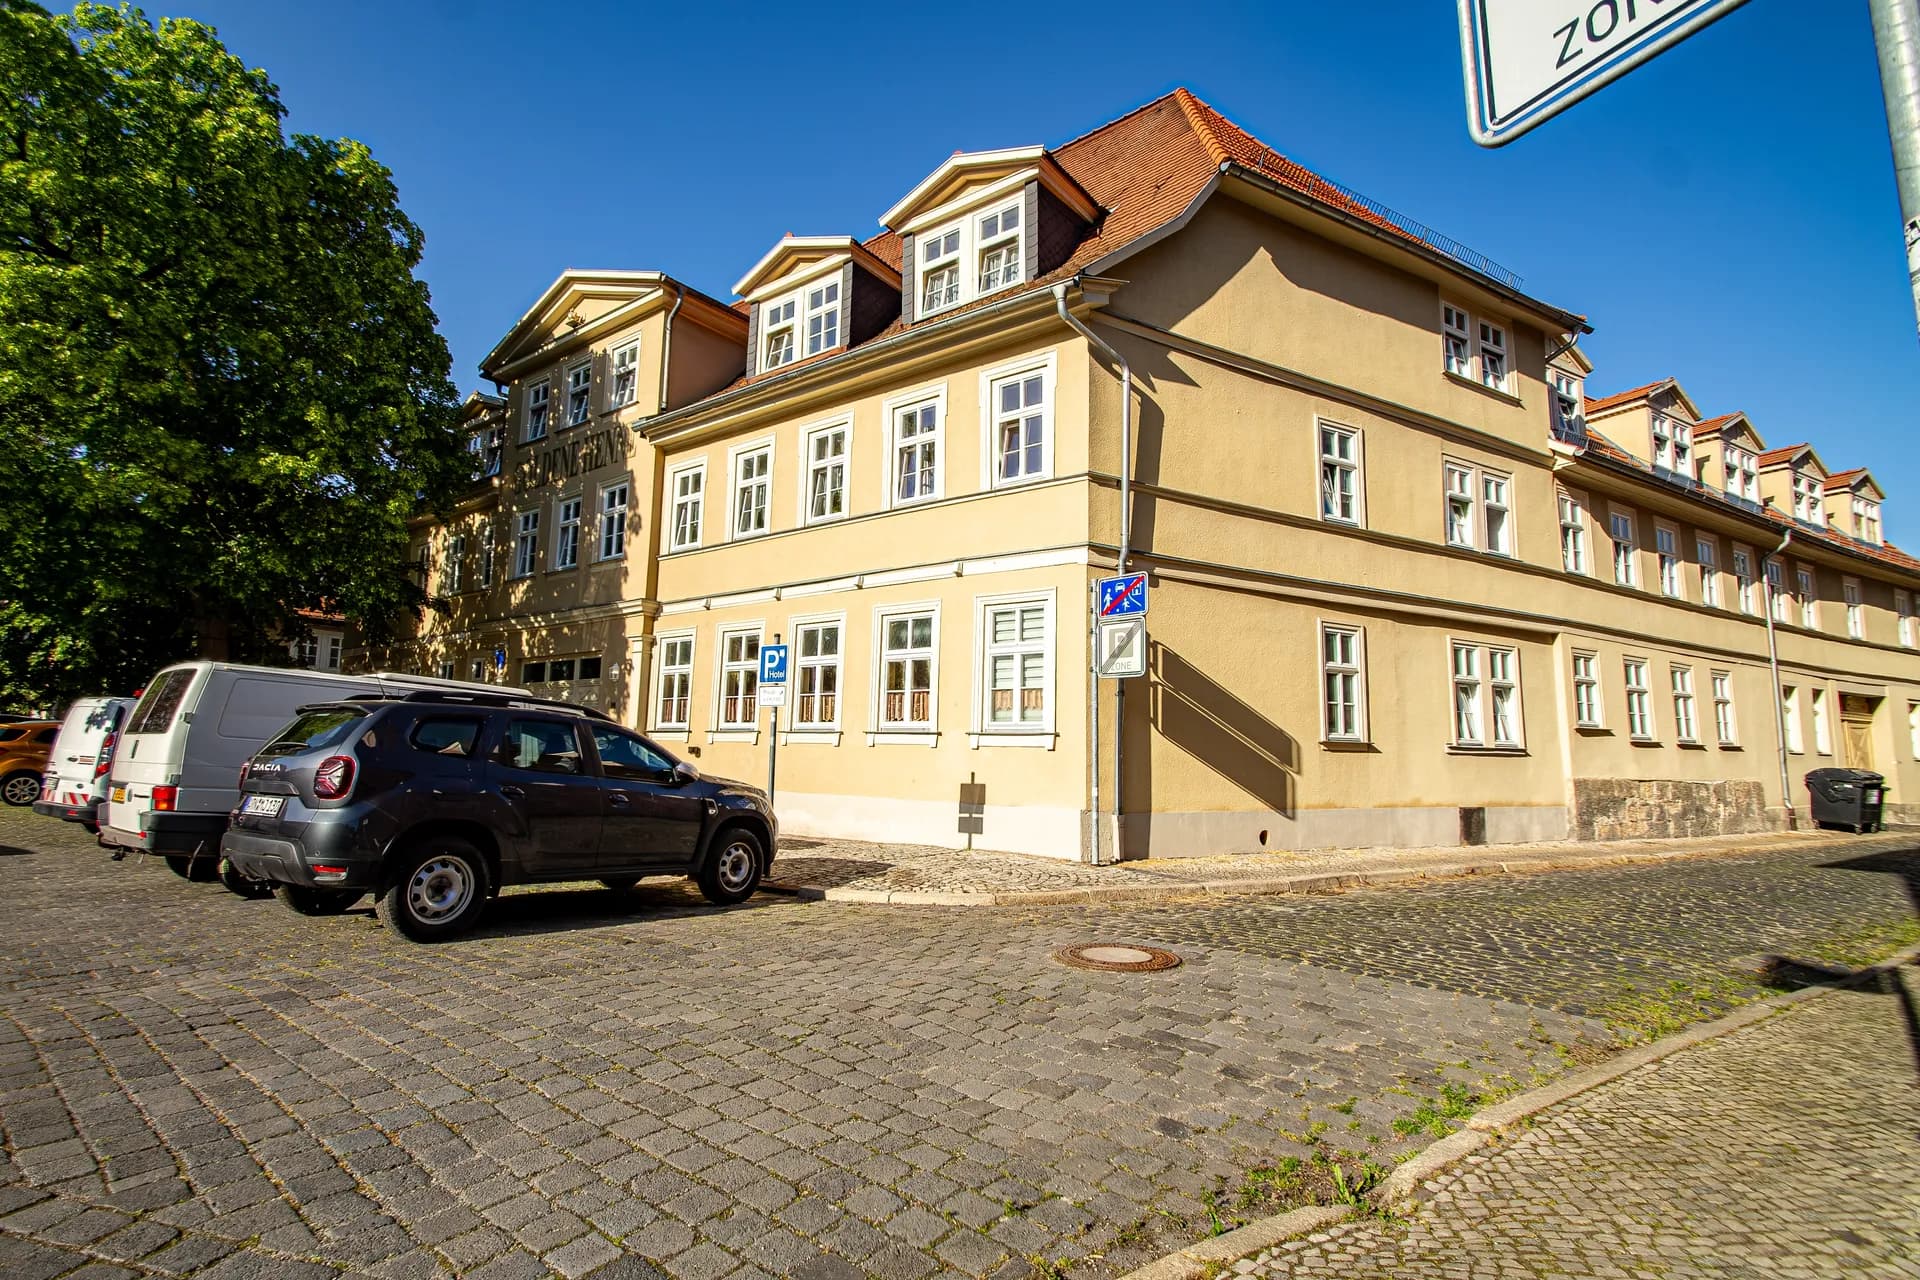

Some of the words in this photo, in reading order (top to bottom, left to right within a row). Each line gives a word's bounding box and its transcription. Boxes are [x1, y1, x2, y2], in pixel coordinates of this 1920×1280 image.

[1553, 0, 1665, 70] ZO
[764, 650, 780, 679] P
[769, 670, 785, 679] Hotel
[252, 764, 281, 772] DACIA
